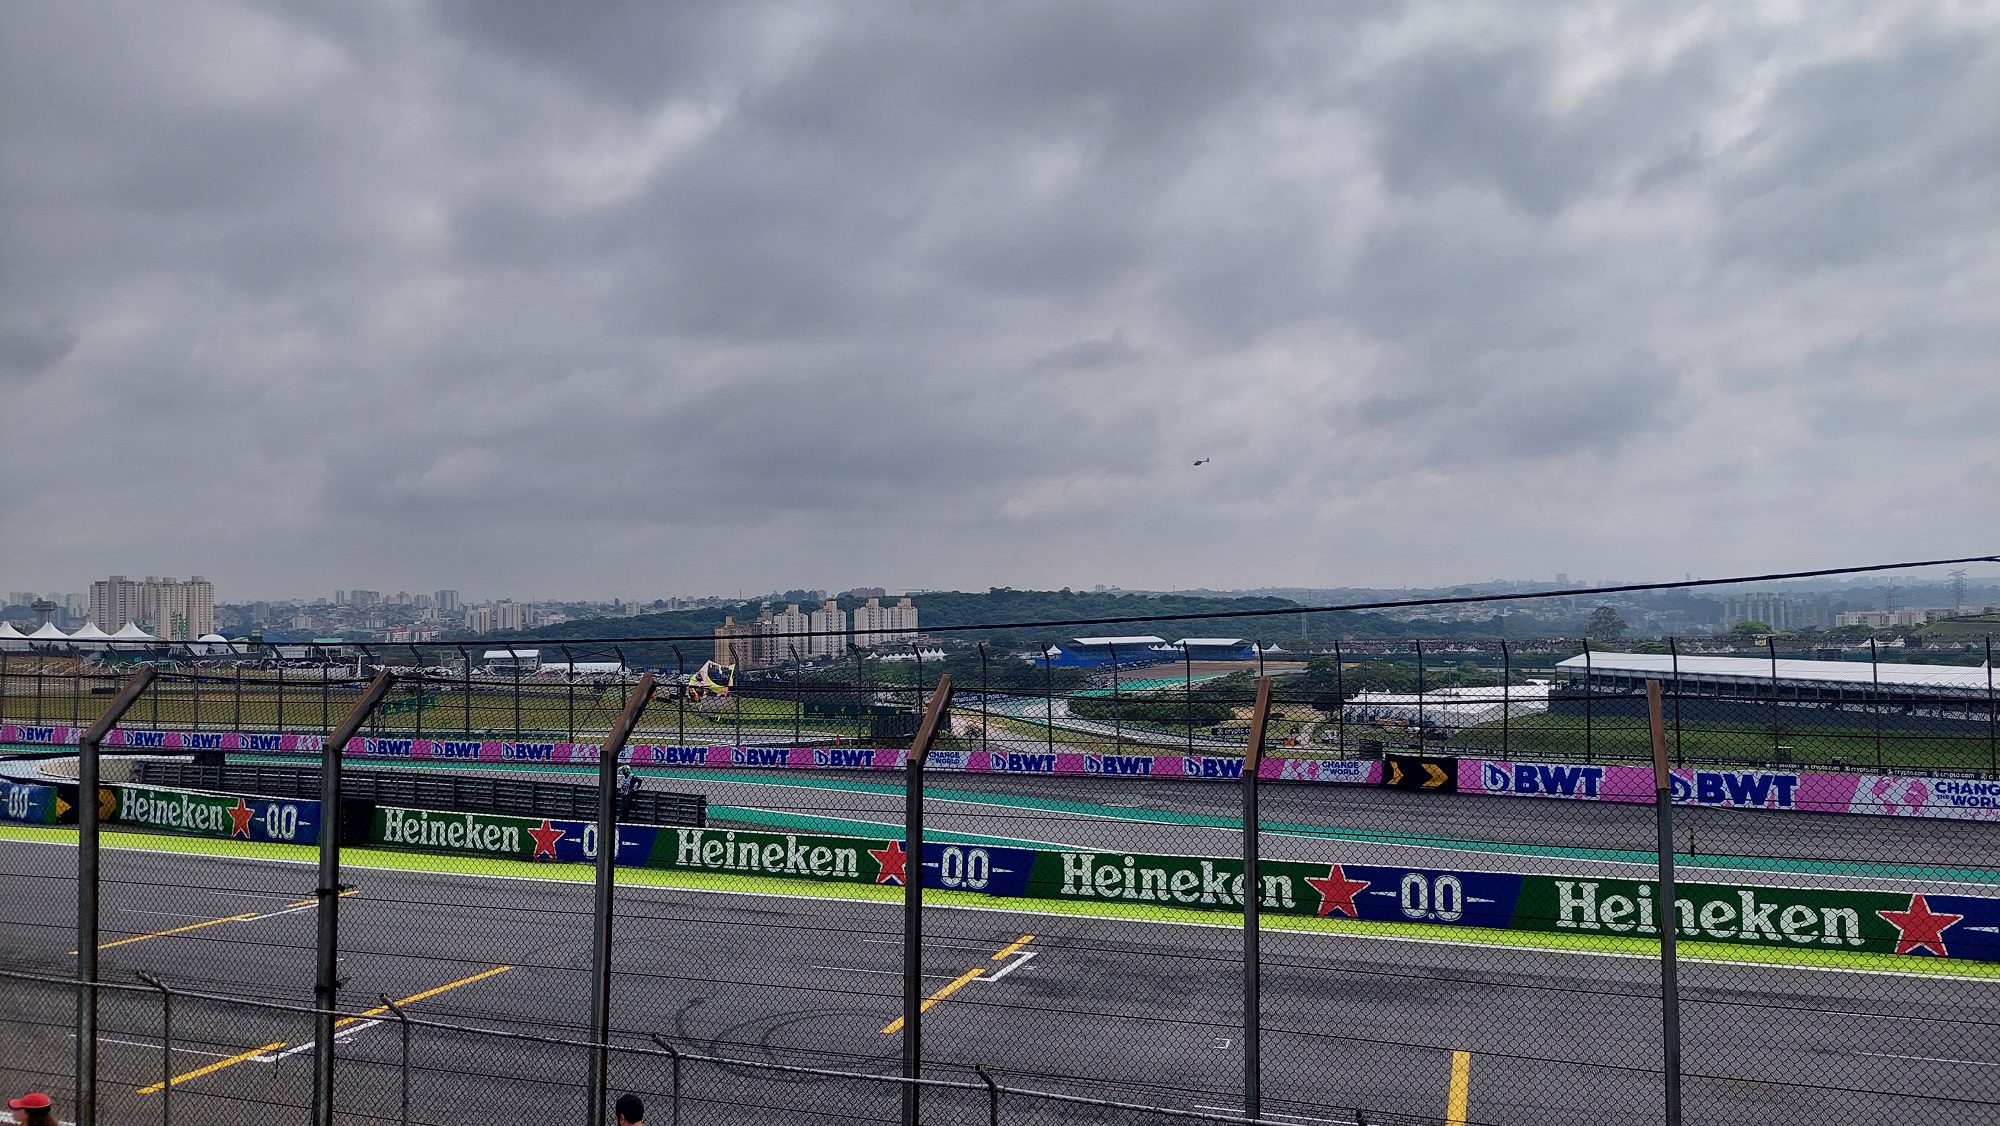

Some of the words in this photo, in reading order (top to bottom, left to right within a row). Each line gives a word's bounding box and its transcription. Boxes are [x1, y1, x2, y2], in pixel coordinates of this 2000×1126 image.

[27, 728, 54, 742] BWT
[135, 733, 164, 746] BWT
[191, 734, 222, 749] BWT
[250, 735, 281, 750] BWT
[376, 739, 412, 757] BWT
[444, 742, 481, 759] BWT
[515, 743, 553, 761] BWT
[666, 746, 707, 765] BWT
[746, 748, 789, 767] BWT
[830, 750, 874, 768] BWT
[1007, 754, 1056, 774] BWT
[1102, 756, 1153, 776] BWT
[1202, 758, 1245, 778] BW
[1514, 764, 1602, 797] BWT
[1697, 771, 1797, 807] BWT
[1935, 781, 2000, 796] CHANG
[9, 786, 30, 819] 0.0
[120, 788, 224, 831] Heineken
[1951, 795, 2000, 808] WORL
[266, 803, 298, 840] 0.0
[383, 808, 521, 853] Heineken
[675, 829, 860, 878] Heineken
[940, 847, 989, 890] 0.0
[1401, 873, 1462, 921] 0.0
